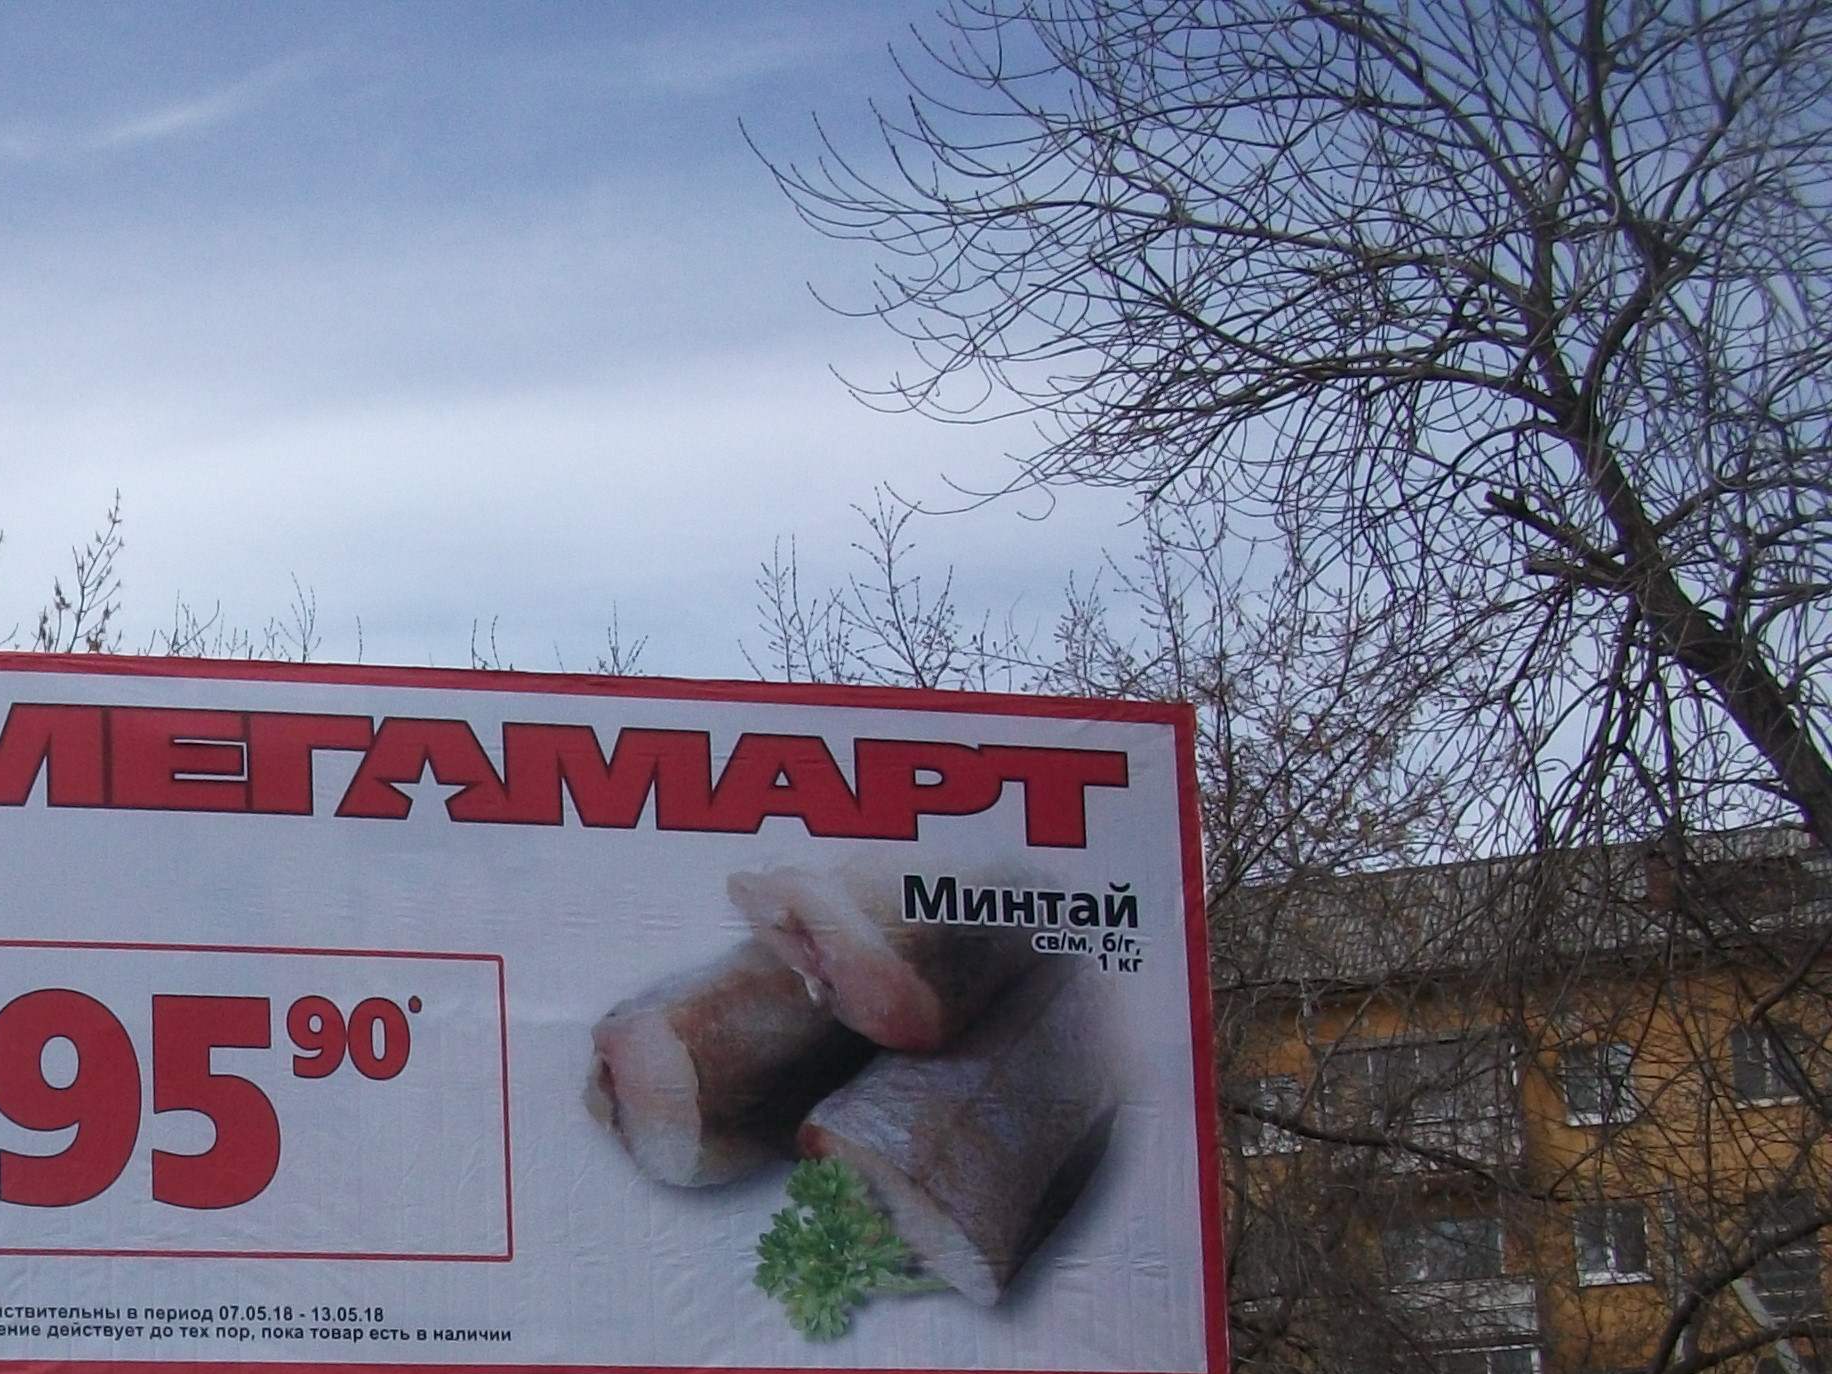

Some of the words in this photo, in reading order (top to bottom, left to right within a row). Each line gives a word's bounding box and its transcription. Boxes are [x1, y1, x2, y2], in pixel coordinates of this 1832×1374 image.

[903, 875, 1138, 928] Минтай
[1034, 932, 1094, 955] св/м,
[1102, 932, 1141, 955] б/г,
[1098, 954, 1109, 971] 1
[1118, 956, 1143, 972] кг
[127, 1309, 137, 1320] в
[144, 1308, 214, 1324] период
[219, 1306, 293, 1321] 07.05.18
[312, 1306, 384, 1322] 13.05.18
[47, 1323, 144, 1341] действует
[150, 1326, 173, 1340] до
[180, 1327, 209, 1339] тех
[216, 1327, 256, 1342] пор,
[261, 1328, 304, 1340] пока
[310, 1328, 364, 1343] товар
[369, 1329, 410, 1341] есть
[417, 1329, 427, 1341] в
[434, 1329, 511, 1342] наличии
